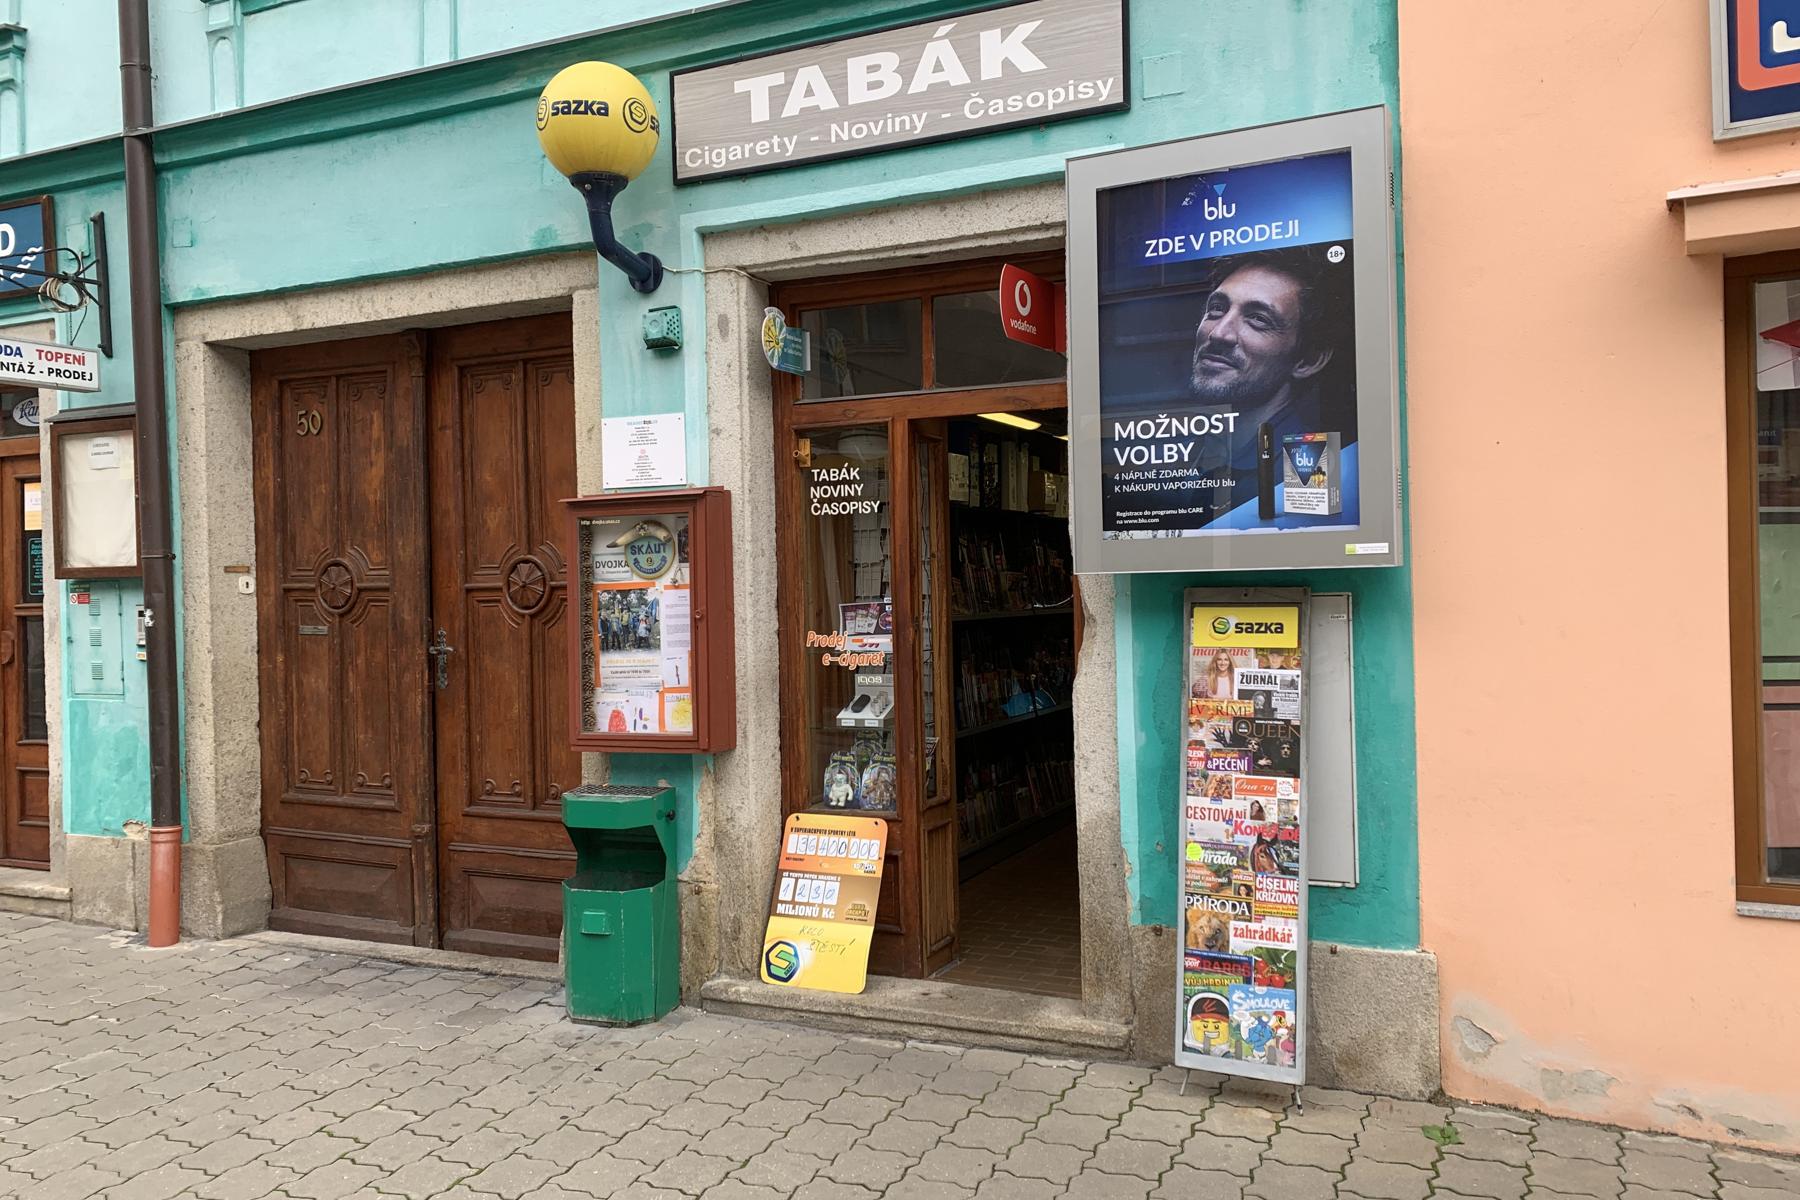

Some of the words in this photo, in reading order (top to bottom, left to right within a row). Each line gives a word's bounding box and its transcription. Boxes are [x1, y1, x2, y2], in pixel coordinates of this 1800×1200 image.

[734, 19, 1048, 124] TABÁK
[551, 99, 609, 117] sazka
[684, 133, 798, 169] Cigarety
[830, 109, 928, 144] Noviny
[963, 76, 1115, 121] Časopisy
[1204, 196, 1236, 221] blu
[1145, 235, 1186, 258] ZDE
[1190, 232, 1205, 251] V
[1210, 219, 1299, 248] PRODEJI
[1329, 250, 1344, 259] 18+
[1010, 318, 1037, 335] vodafone
[36, 349, 86, 366] TOPENÍ
[48, 367, 93, 381] PRODEJ
[297, 410, 321, 436] 50
[1113, 412, 1240, 442] MOŽNOST
[1113, 442, 1195, 466] VOLBY
[1296, 453, 1314, 467] blu
[811, 462, 860, 482] TABÁK
[1114, 473, 1120, 481] 4
[1121, 469, 1157, 481] NÁPLNĚ
[1159, 468, 1200, 479] ZDARMA
[810, 483, 864, 499] NOVINY
[1114, 485, 1121, 493] K
[1122, 482, 1161, 493] NÁKUPU
[1162, 479, 1220, 490] VAPORIZÉRU
[1222, 478, 1236, 488] blu
[811, 498, 880, 516] ČASOPISY
[1152, 508, 1177, 516] programu
[595, 560, 629, 569] DVOJKA
[1234, 622, 1284, 634] sazka
[806, 631, 848, 651] Prodej
[1240, 671, 1278, 686] ŽURNÁL
[1235, 719, 1300, 738] QUEEN
[1186, 805, 1248, 822] CESTOVÁNÍ
[776, 903, 819, 918] MILIONŮ
[822, 907, 835, 918] Kč
[1185, 894, 1250, 916] PŘÍRODA
[1233, 925, 1293, 944] zahrádkář
